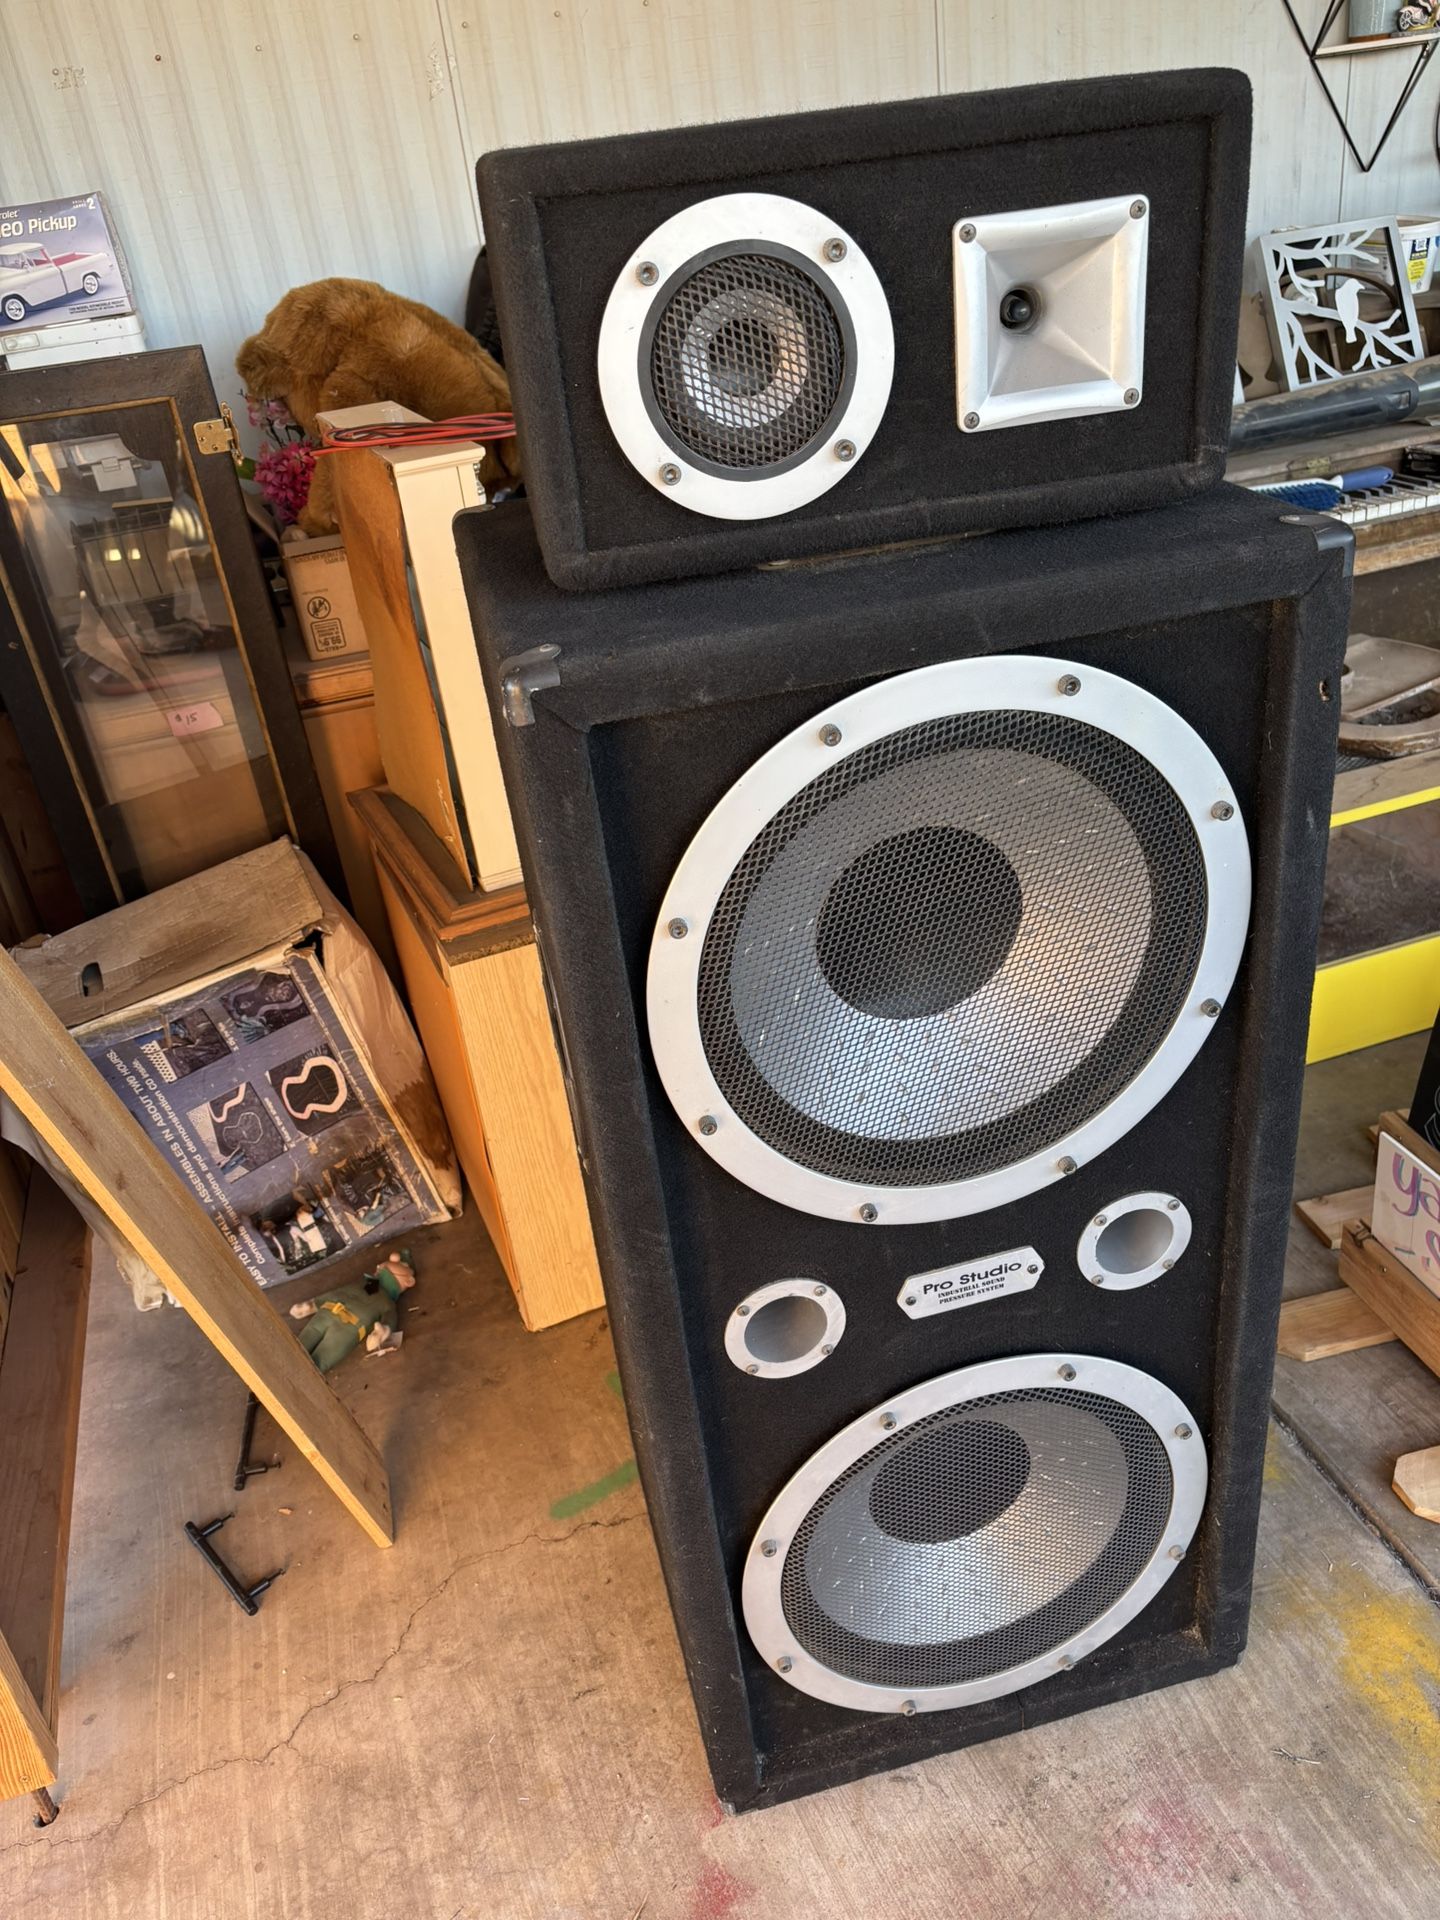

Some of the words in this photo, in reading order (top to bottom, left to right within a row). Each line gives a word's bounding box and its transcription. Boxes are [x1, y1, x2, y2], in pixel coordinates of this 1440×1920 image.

[86, 198, 96, 210] 2
[0, 221, 23, 238] eo
[28, 215, 77, 234] Pickup
[105, 1048, 131, 1079] HOURS.
[125, 1073, 144, 1096] TWO
[145, 1077, 158, 1092] CD
[139, 1092, 167, 1129] ABOUT
[152, 1090, 199, 1155] demonstration
[161, 1128, 175, 1142] IN
[168, 1141, 215, 1205] ASSEMBLES
[192, 1153, 209, 1174] and
[203, 1171, 243, 1227] instructions
[212, 1211, 244, 1253] INSTALL
[236, 1225, 267, 1265] Complete
[238, 1251, 252, 1266] TO
[247, 1263, 267, 1288] EASY
[923, 1281, 953, 1294] Pro
[959, 1263, 1022, 1284] Studio
[938, 1284, 979, 1298] INDUSTRIAL
[982, 1276, 1005, 1287] SOUND
[939, 1292, 975, 1304] PRESSURE
[977, 1283, 1005, 1294] SYSTEM
